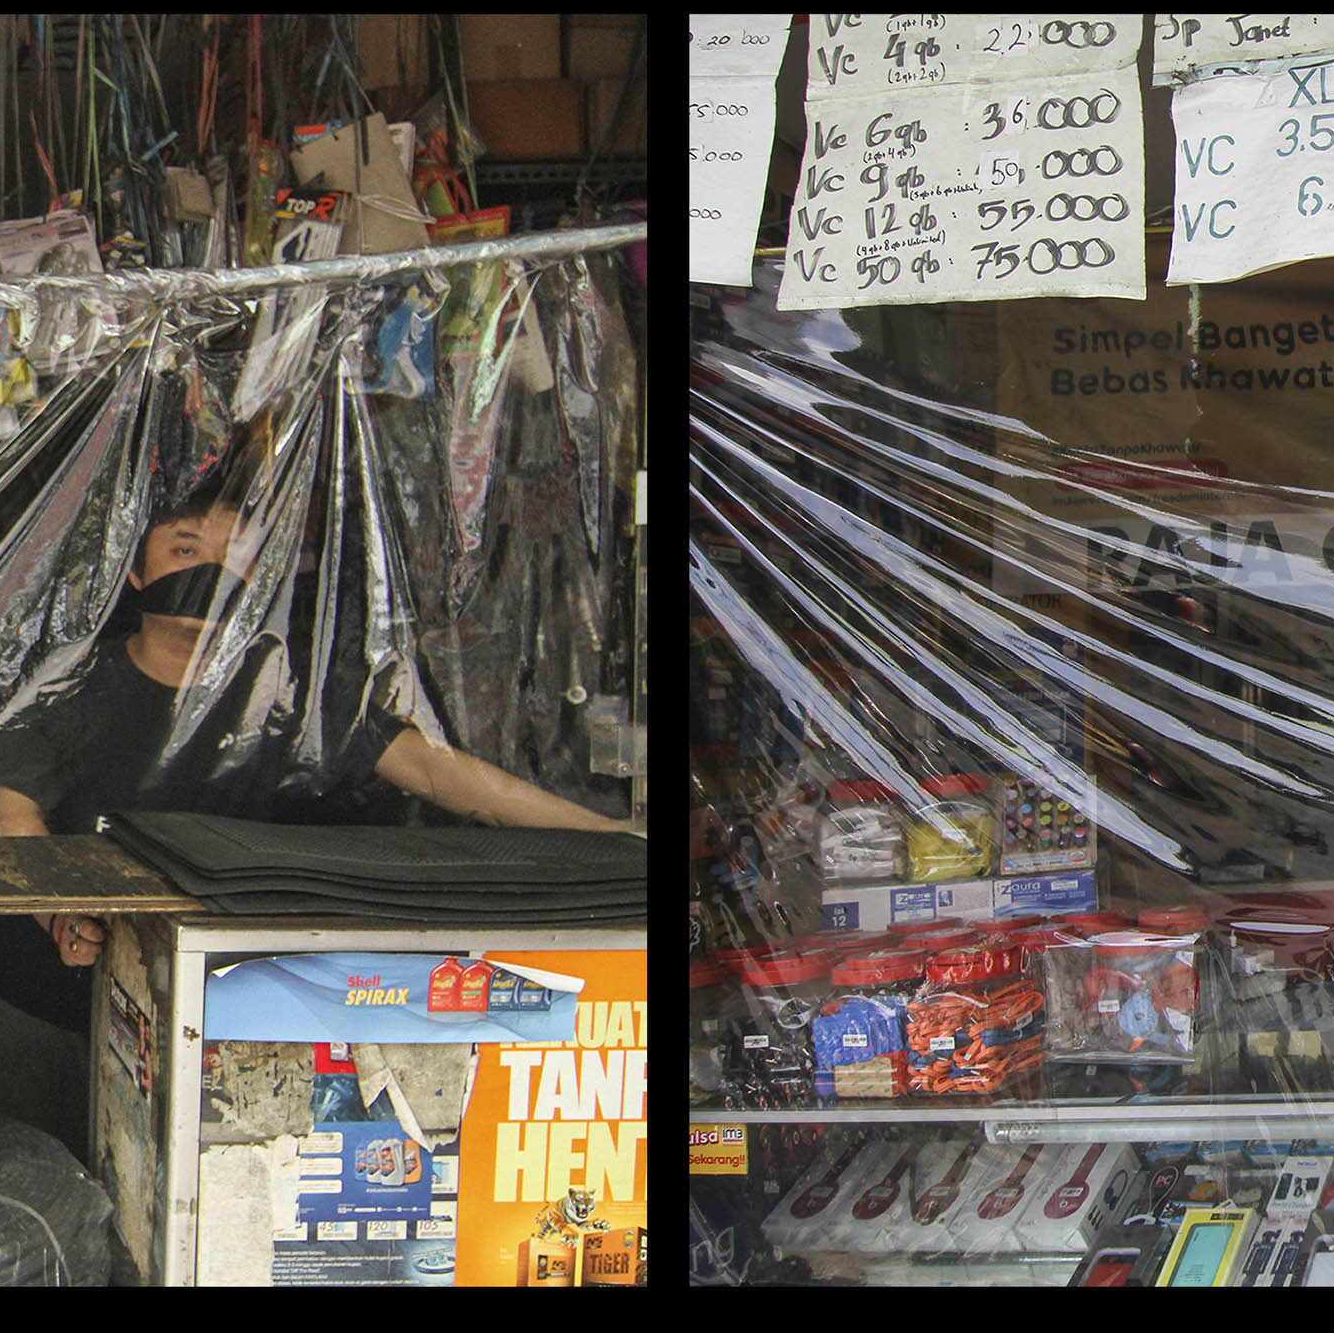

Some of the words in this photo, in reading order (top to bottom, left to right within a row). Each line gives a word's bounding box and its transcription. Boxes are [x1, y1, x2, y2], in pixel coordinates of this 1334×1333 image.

[1183, 135, 1235, 178] VC
[865, 203, 902, 239] 12
[1182, 200, 1237, 242] VC
[857, 256, 900, 289] 50
[1052, 321, 1183, 359] Simpel
[1051, 369, 1167, 395] Bebas
[346, 989, 408, 1006] SPIRAX
[347, 975, 380, 988] Shell
[589, 1253, 631, 1275] TIGER
